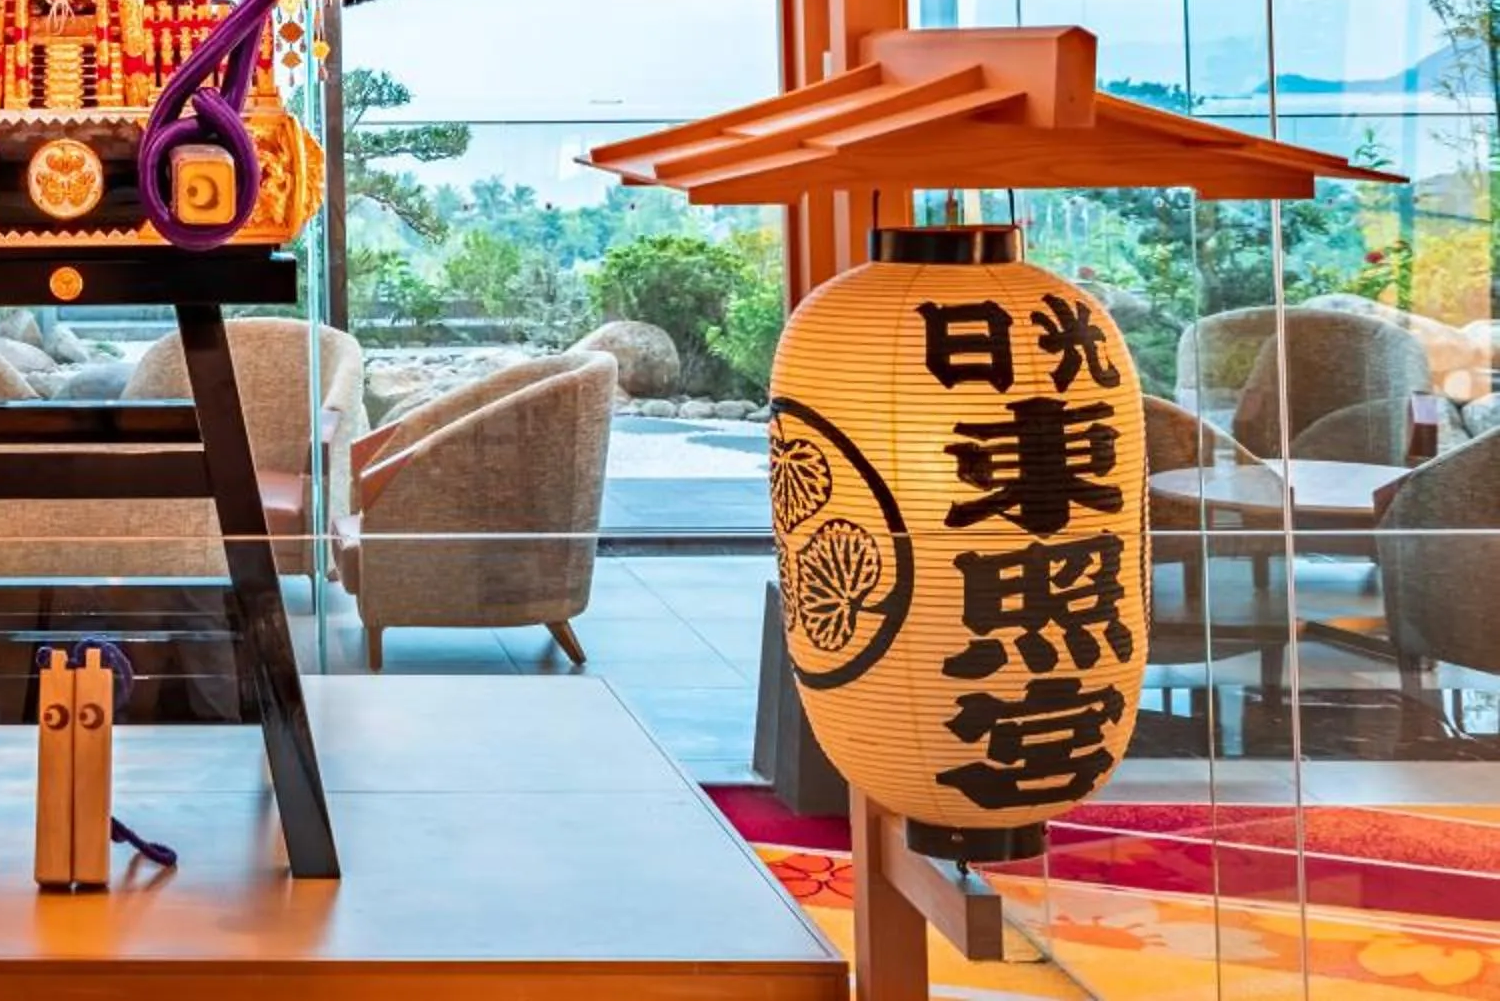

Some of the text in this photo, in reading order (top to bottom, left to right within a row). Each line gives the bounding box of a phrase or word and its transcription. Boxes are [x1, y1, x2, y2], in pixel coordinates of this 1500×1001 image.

[916, 294, 1121, 393] 日光
[936, 398, 1134, 810] 東照宮
